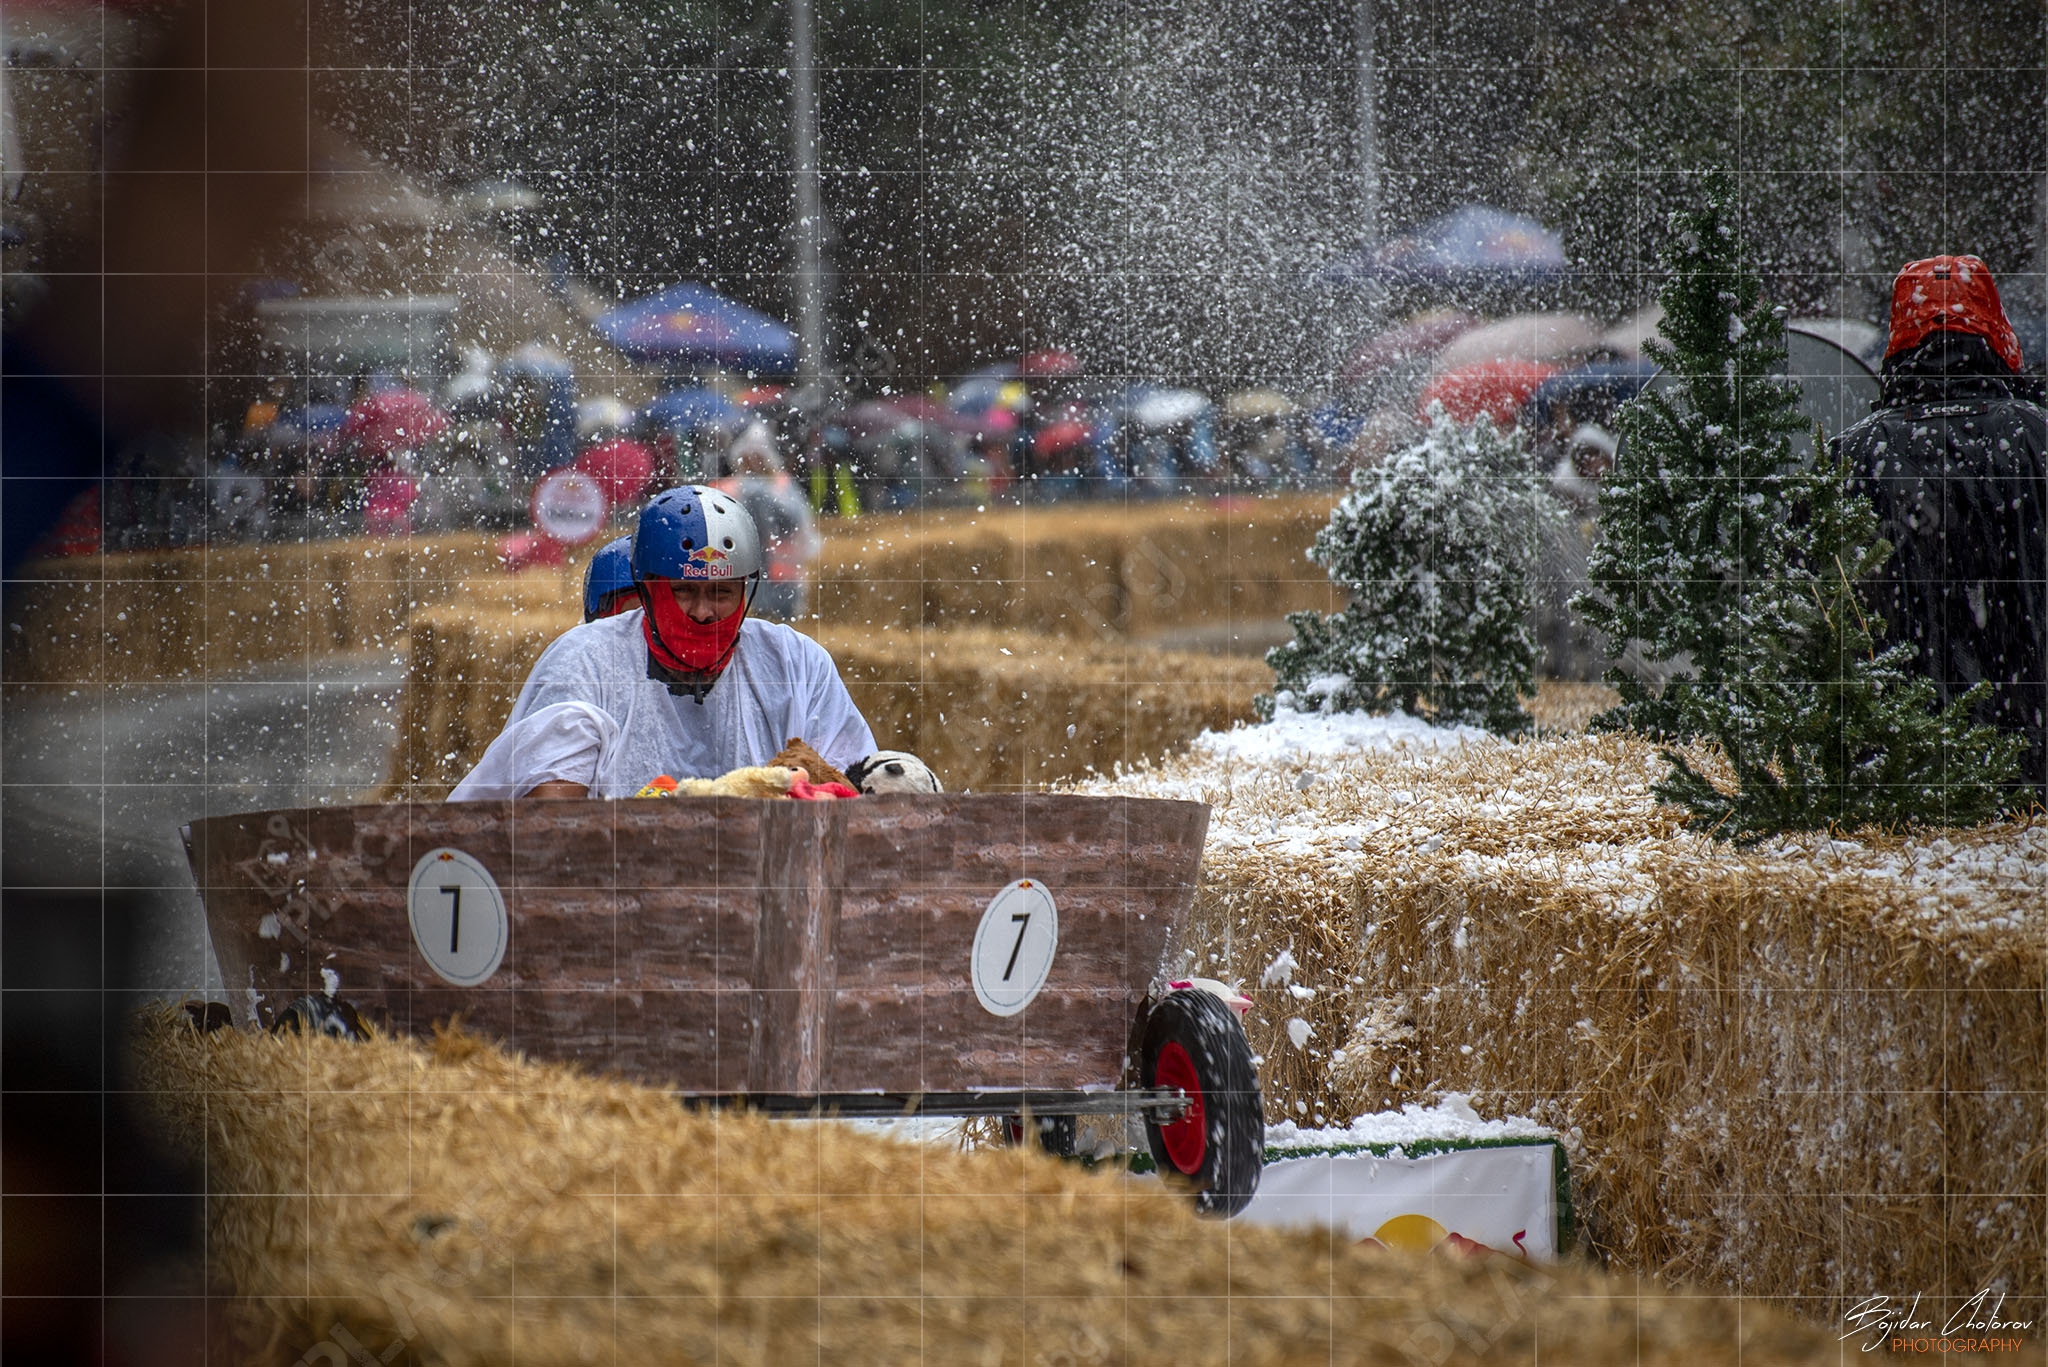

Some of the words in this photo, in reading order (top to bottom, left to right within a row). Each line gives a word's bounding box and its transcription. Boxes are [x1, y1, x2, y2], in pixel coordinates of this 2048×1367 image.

[683, 563, 708, 577] Red
[710, 564, 733, 577] Bull
[439, 885, 461, 953] 7
[1002, 913, 1031, 982] 7
